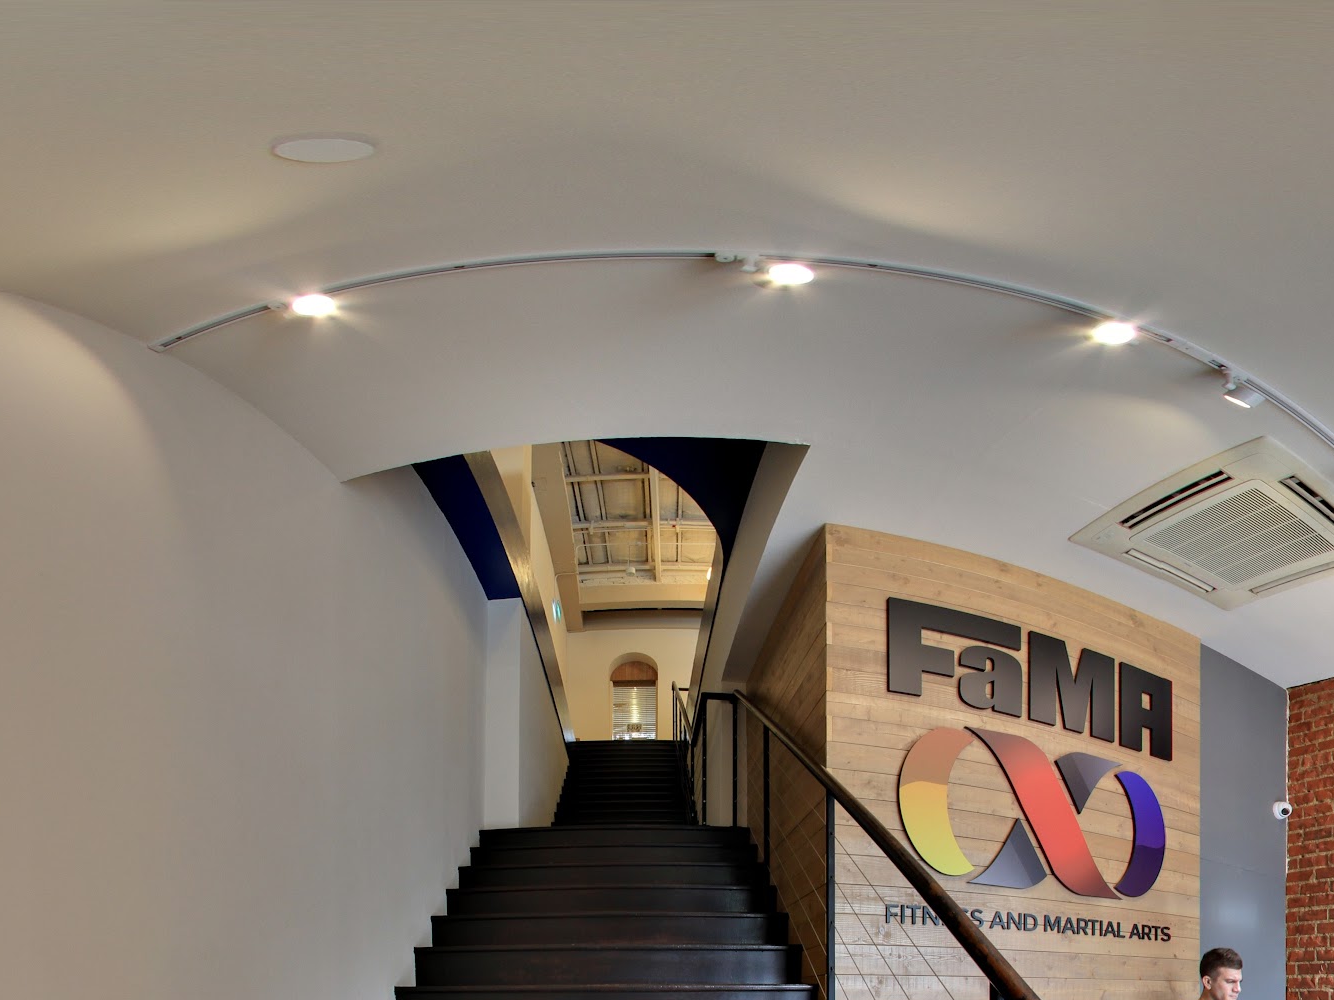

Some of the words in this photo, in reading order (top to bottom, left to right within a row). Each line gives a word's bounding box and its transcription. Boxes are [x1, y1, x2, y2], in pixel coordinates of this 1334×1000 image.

[886, 596, 1173, 761] FaMA
[885, 903, 984, 928] FITNS
[989, 911, 1038, 932] AND
[1043, 914, 1125, 939] MARTIAL
[1129, 923, 1172, 942] ARTS
